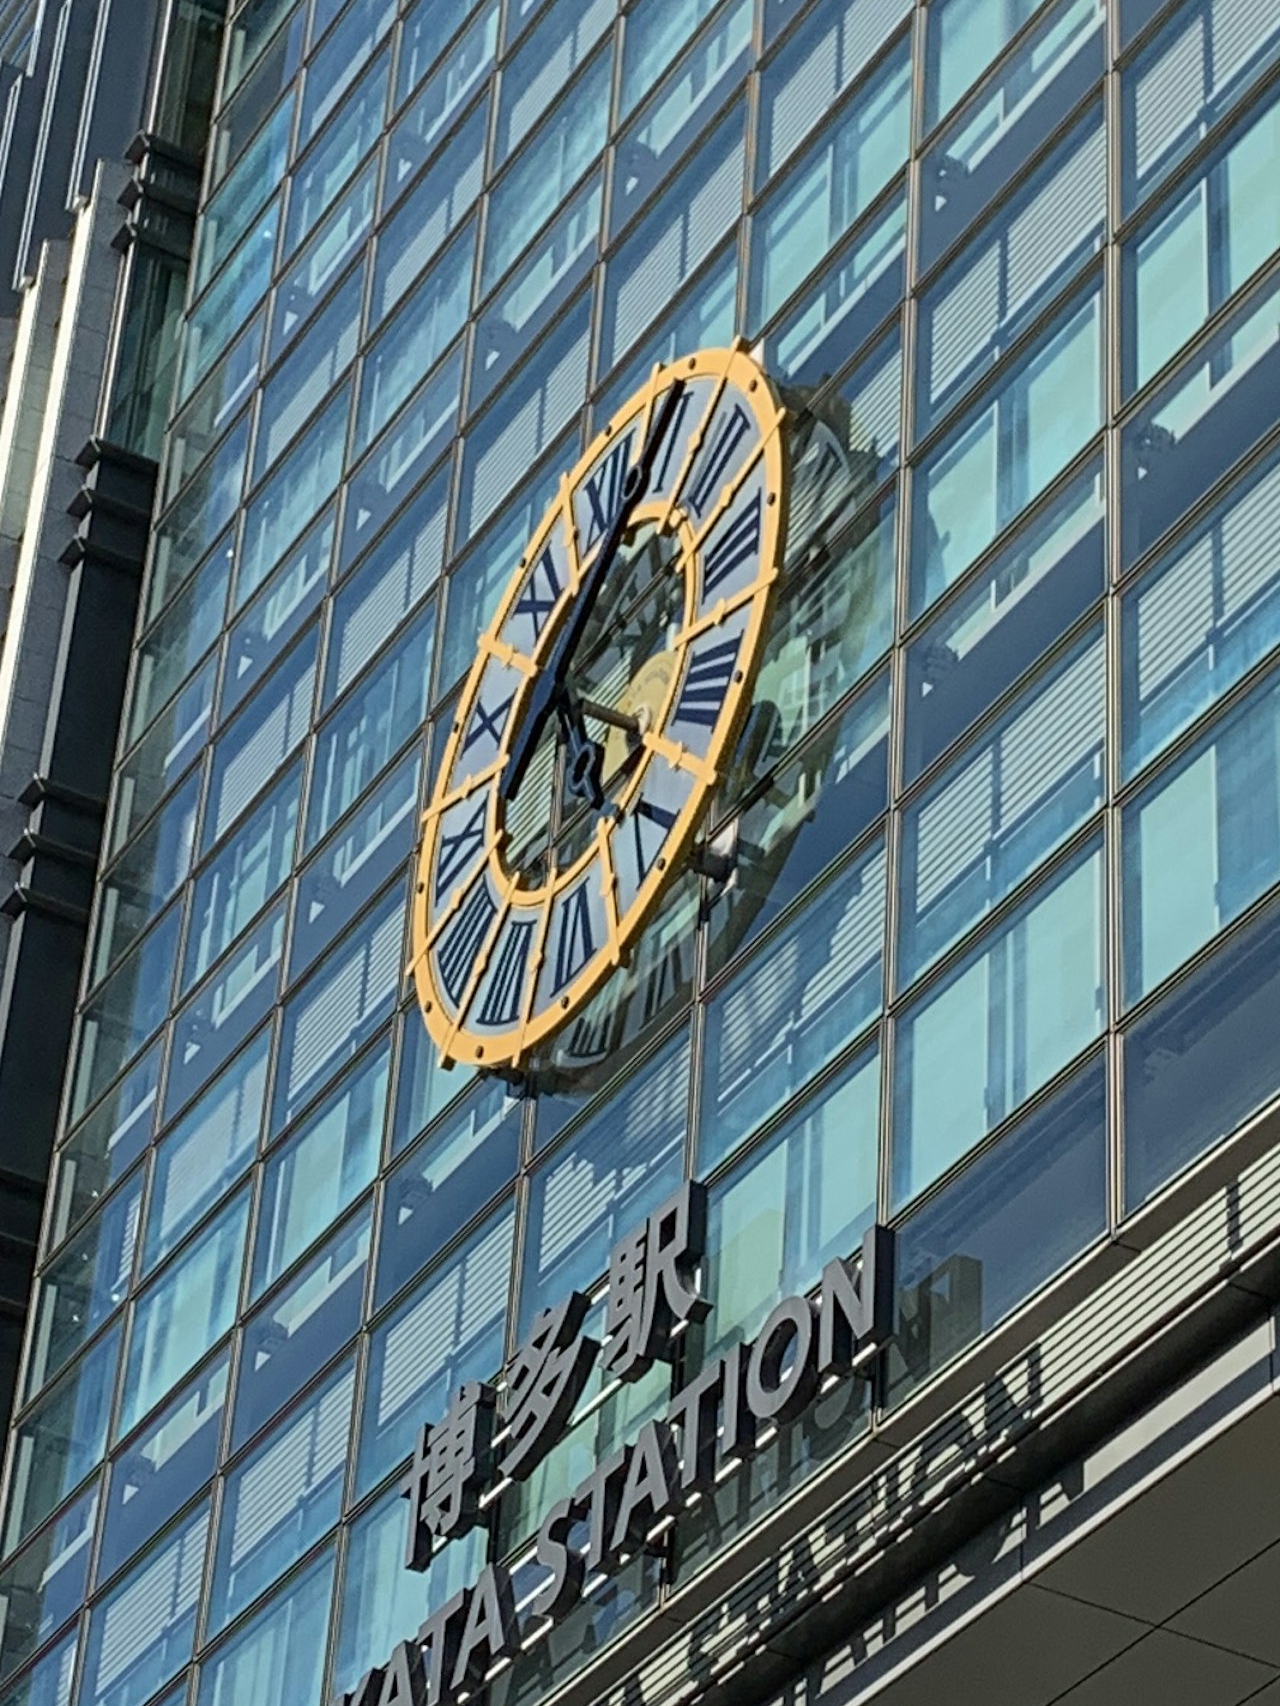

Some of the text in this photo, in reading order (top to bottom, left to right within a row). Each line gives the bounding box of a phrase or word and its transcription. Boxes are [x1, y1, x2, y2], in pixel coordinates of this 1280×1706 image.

[401, 1179, 713, 1572] 博多駅
[533, 1224, 895, 1623] STATION
